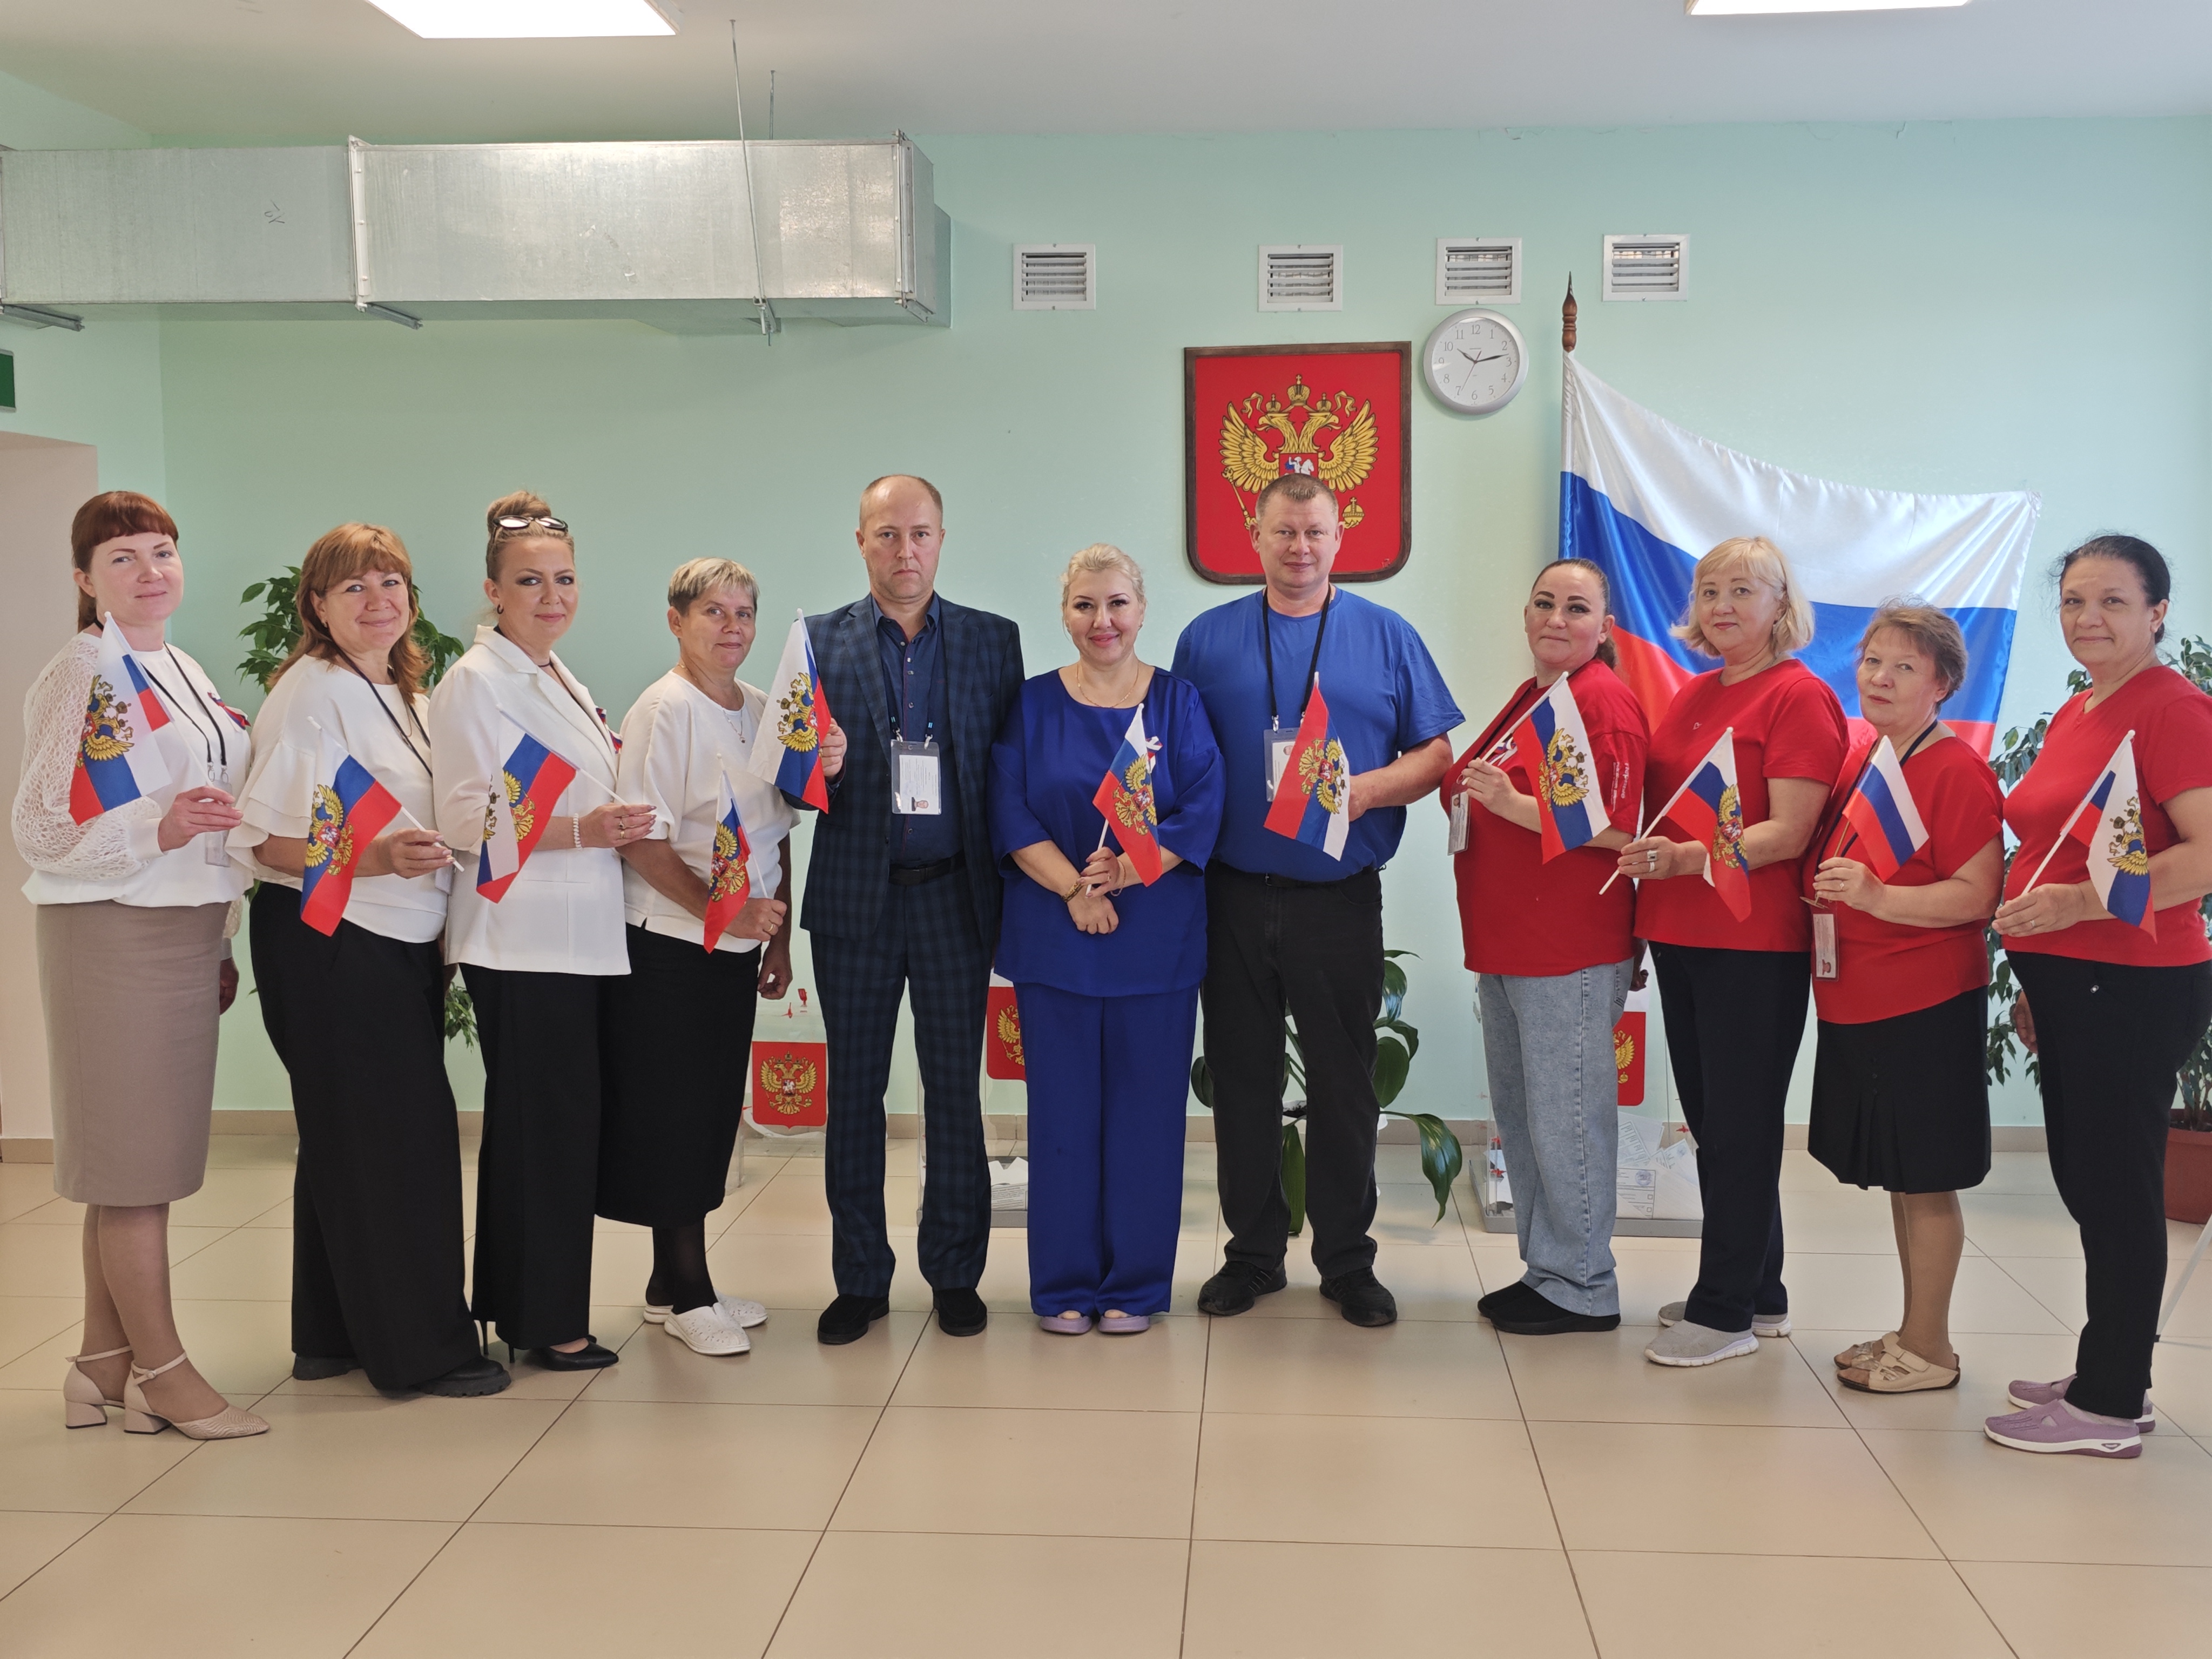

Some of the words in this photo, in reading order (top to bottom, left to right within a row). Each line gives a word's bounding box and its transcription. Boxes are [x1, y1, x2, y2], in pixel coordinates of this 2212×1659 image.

[1455, 330, 1464, 340] 11
[1472, 325, 1481, 335] 12
[1490, 330, 1494, 339] 1
[1444, 342, 1453, 352] 10
[1501, 341, 1508, 351] 2
[1438, 358, 1445, 366] 9
[1506, 358, 1512, 367] 3
[1444, 374, 1449, 383] 8
[1501, 373, 1507, 383] 4
[1455, 386, 1461, 396] 7
[1471, 390, 1478, 400] 6
[1488, 386, 1494, 395] 5
